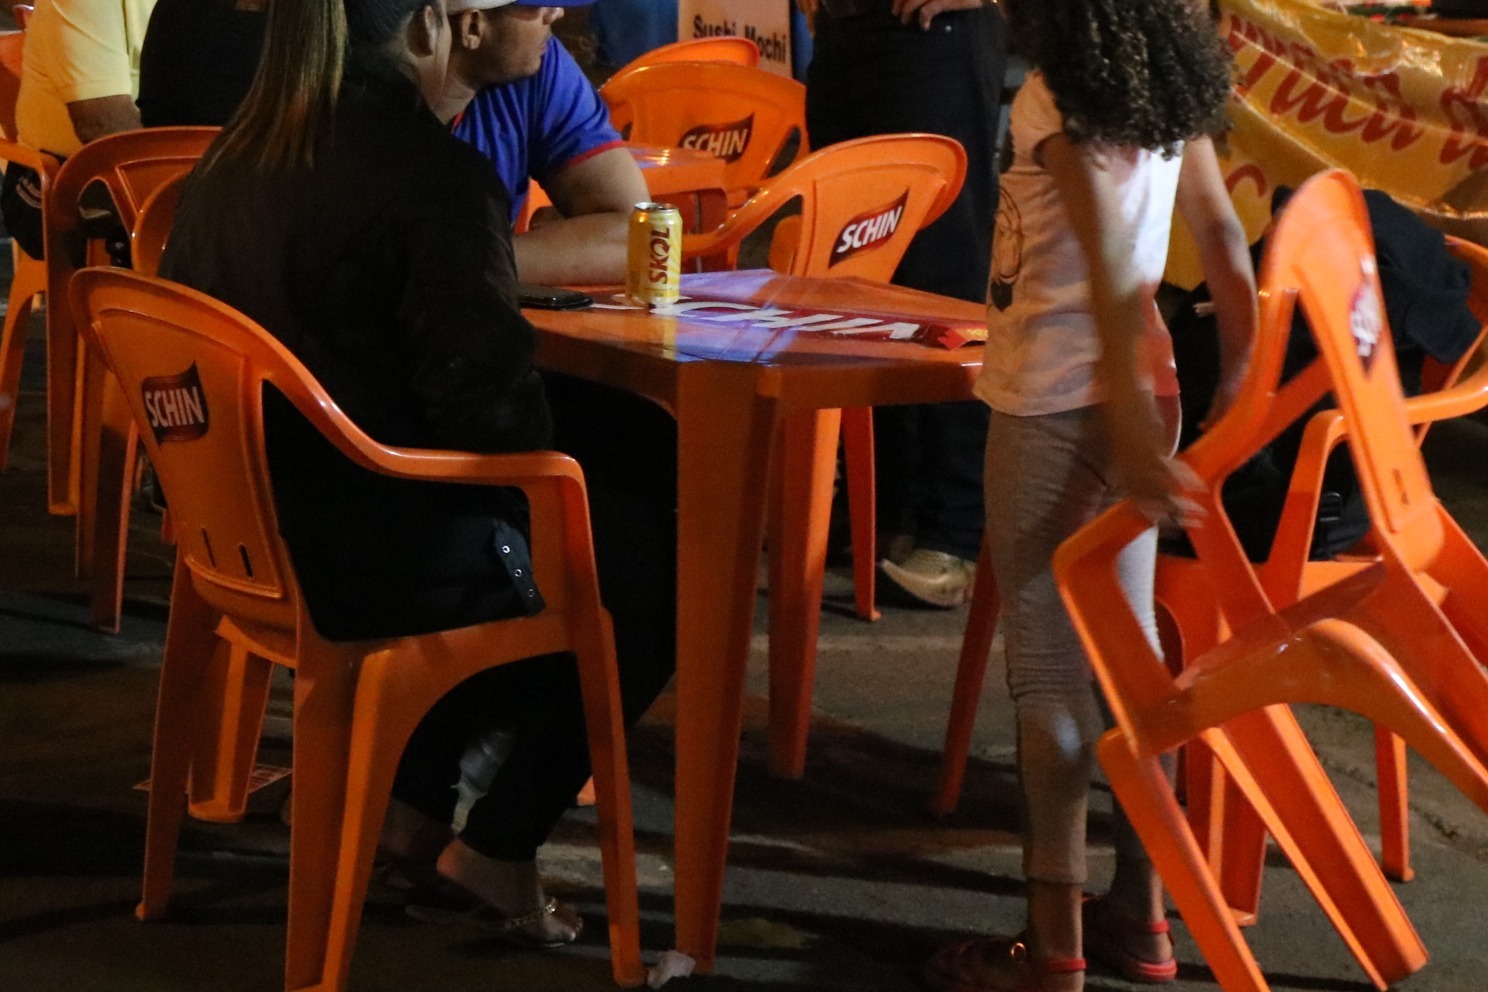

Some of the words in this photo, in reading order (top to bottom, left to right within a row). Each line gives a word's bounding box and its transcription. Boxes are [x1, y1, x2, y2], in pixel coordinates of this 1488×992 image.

[744, 23, 787, 64] Mochi
[682, 128, 748, 158] SCHIN
[836, 205, 904, 255] SCHIN
[647, 226, 672, 285] SKOL
[144, 387, 205, 428] SCHIN
